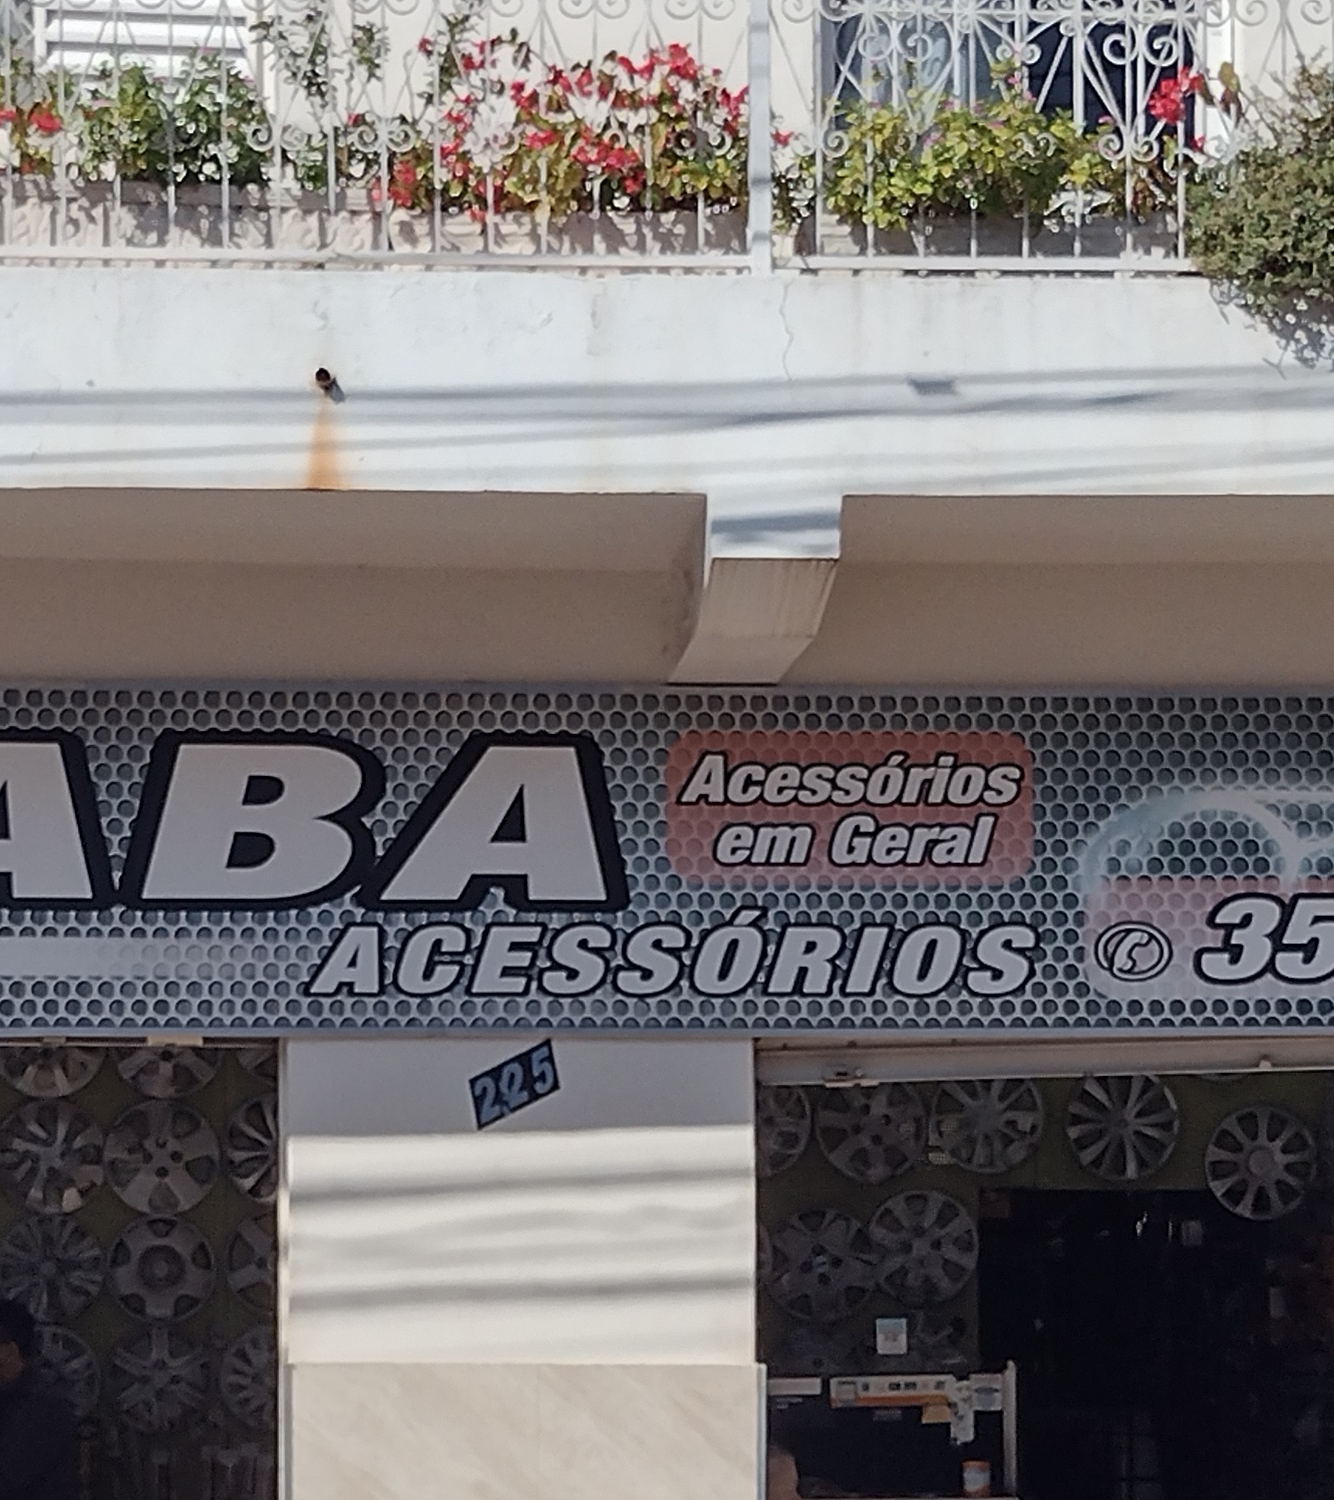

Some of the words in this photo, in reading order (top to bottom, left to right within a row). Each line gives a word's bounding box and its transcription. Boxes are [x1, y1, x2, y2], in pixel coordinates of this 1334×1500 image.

[679, 753, 1023, 806] Acessórios
[713, 823, 814, 867] em
[827, 814, 997, 867] Geral
[307, 908, 1039, 998] ACESSÓRIOS
